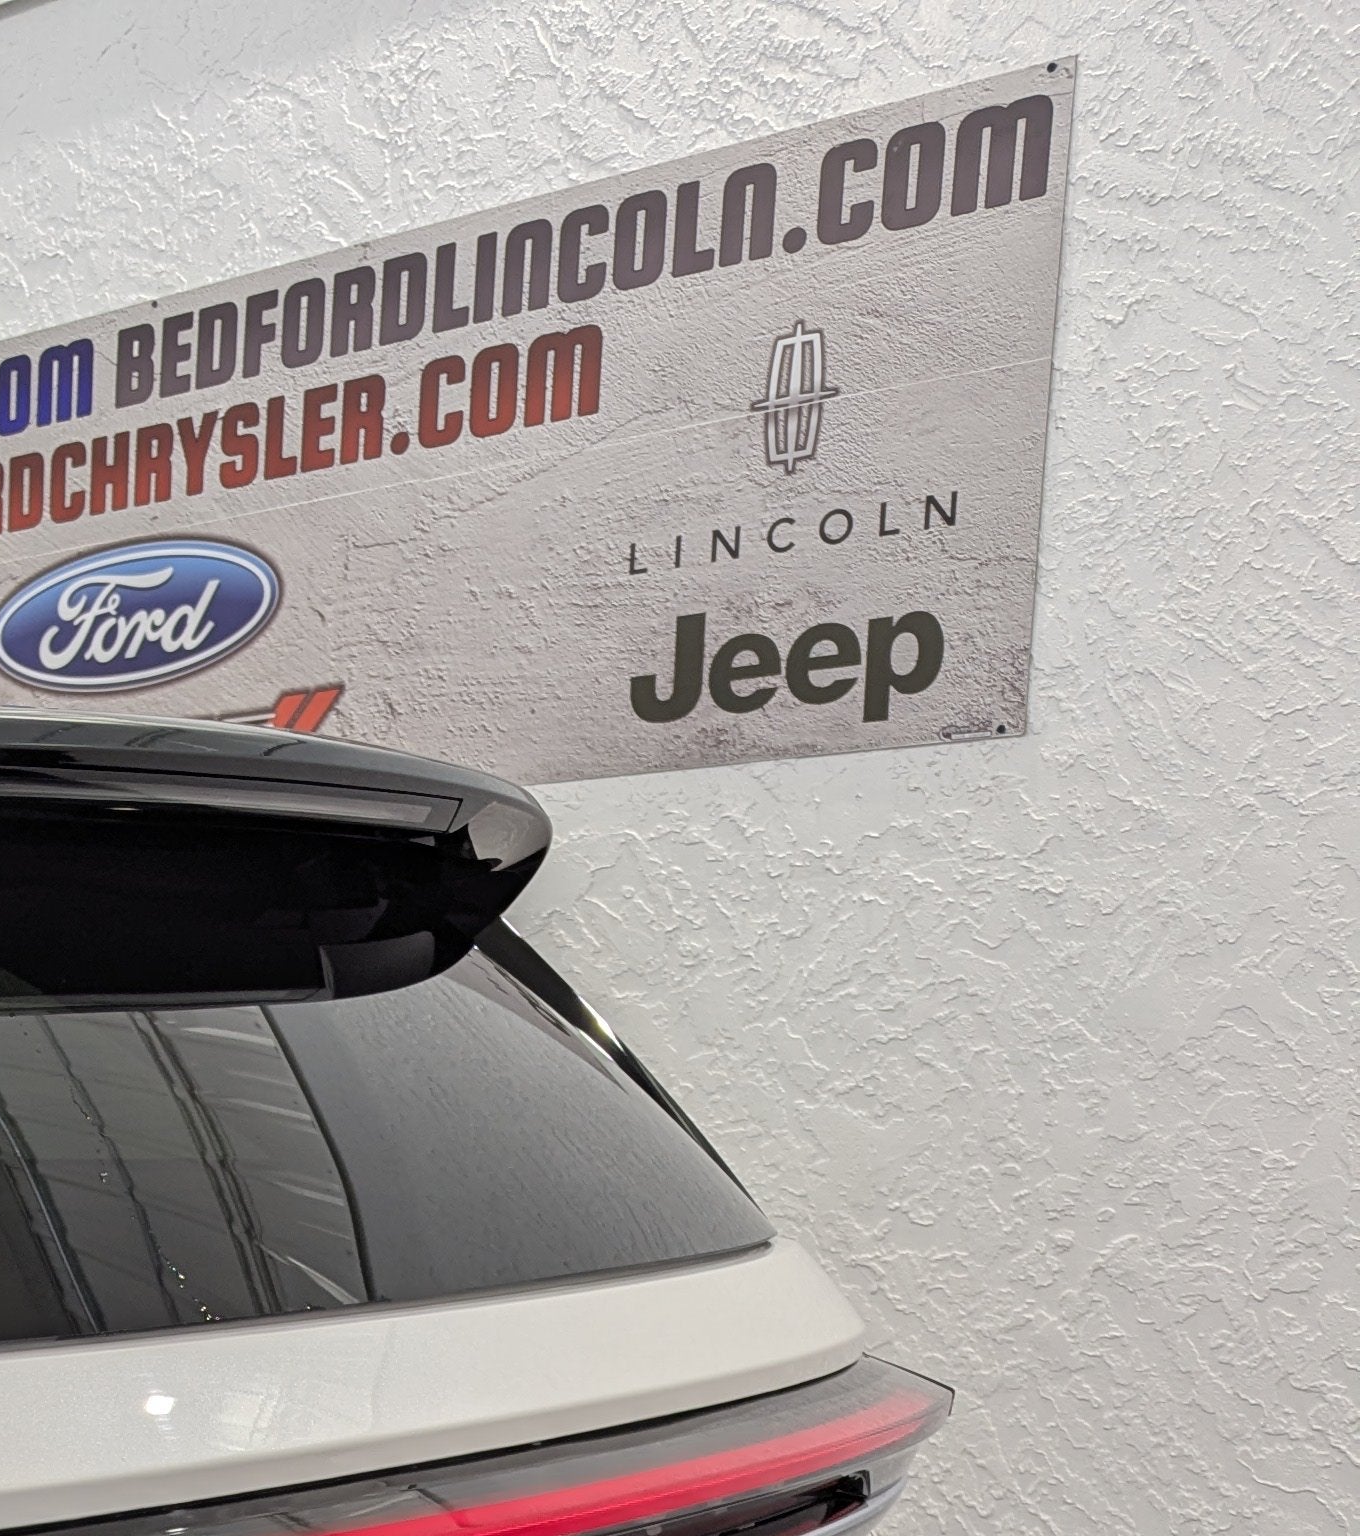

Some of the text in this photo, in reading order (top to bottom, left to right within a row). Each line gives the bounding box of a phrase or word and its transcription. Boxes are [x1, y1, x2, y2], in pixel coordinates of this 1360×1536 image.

[114, 93, 1054, 409] BEDFORDLINCOLN.COM
[627, 490, 959, 576] LINCOLN
[38, 565, 221, 671] Ford
[629, 608, 945, 724] Jeep
